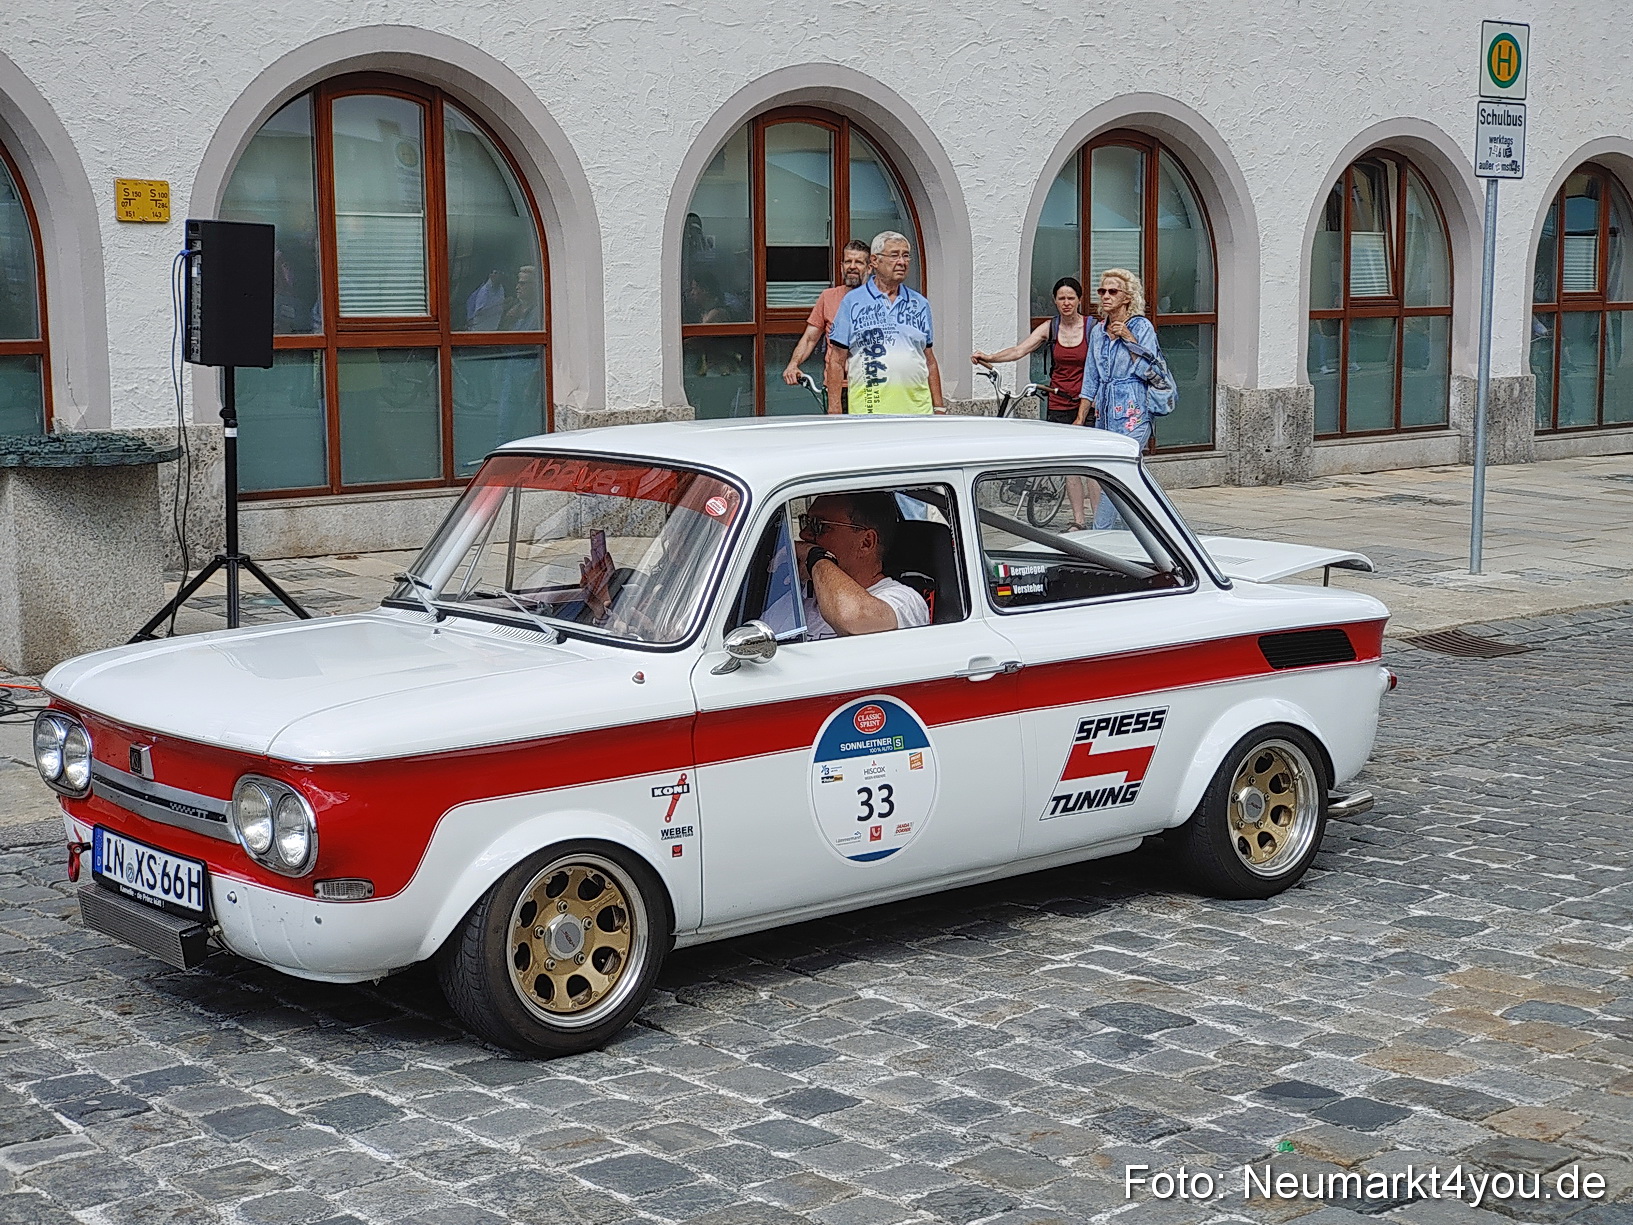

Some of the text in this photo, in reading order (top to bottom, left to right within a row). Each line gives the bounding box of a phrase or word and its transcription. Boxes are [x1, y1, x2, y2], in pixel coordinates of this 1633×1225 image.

[1480, 108, 1523, 126] Schulbus
[1488, 135, 1513, 147] werktags
[1479, 160, 1494, 170] außer
[123, 188, 130, 197] S
[150, 189, 156, 198] S
[897, 312, 926, 332] CREW
[1012, 583, 1043, 594] Versteher
[858, 713, 882, 721] CLASSIC
[860, 720, 880, 728] SPRINT
[1075, 710, 1166, 742] SPIESS
[840, 738, 892, 751] SONNLEITNER
[864, 766, 886, 775] HISCOX
[654, 784, 688, 796] KONI
[857, 784, 895, 822] 33
[1050, 782, 1141, 815] TUNING
[661, 826, 693, 836] WEBER
[105, 838, 124, 878] IN
